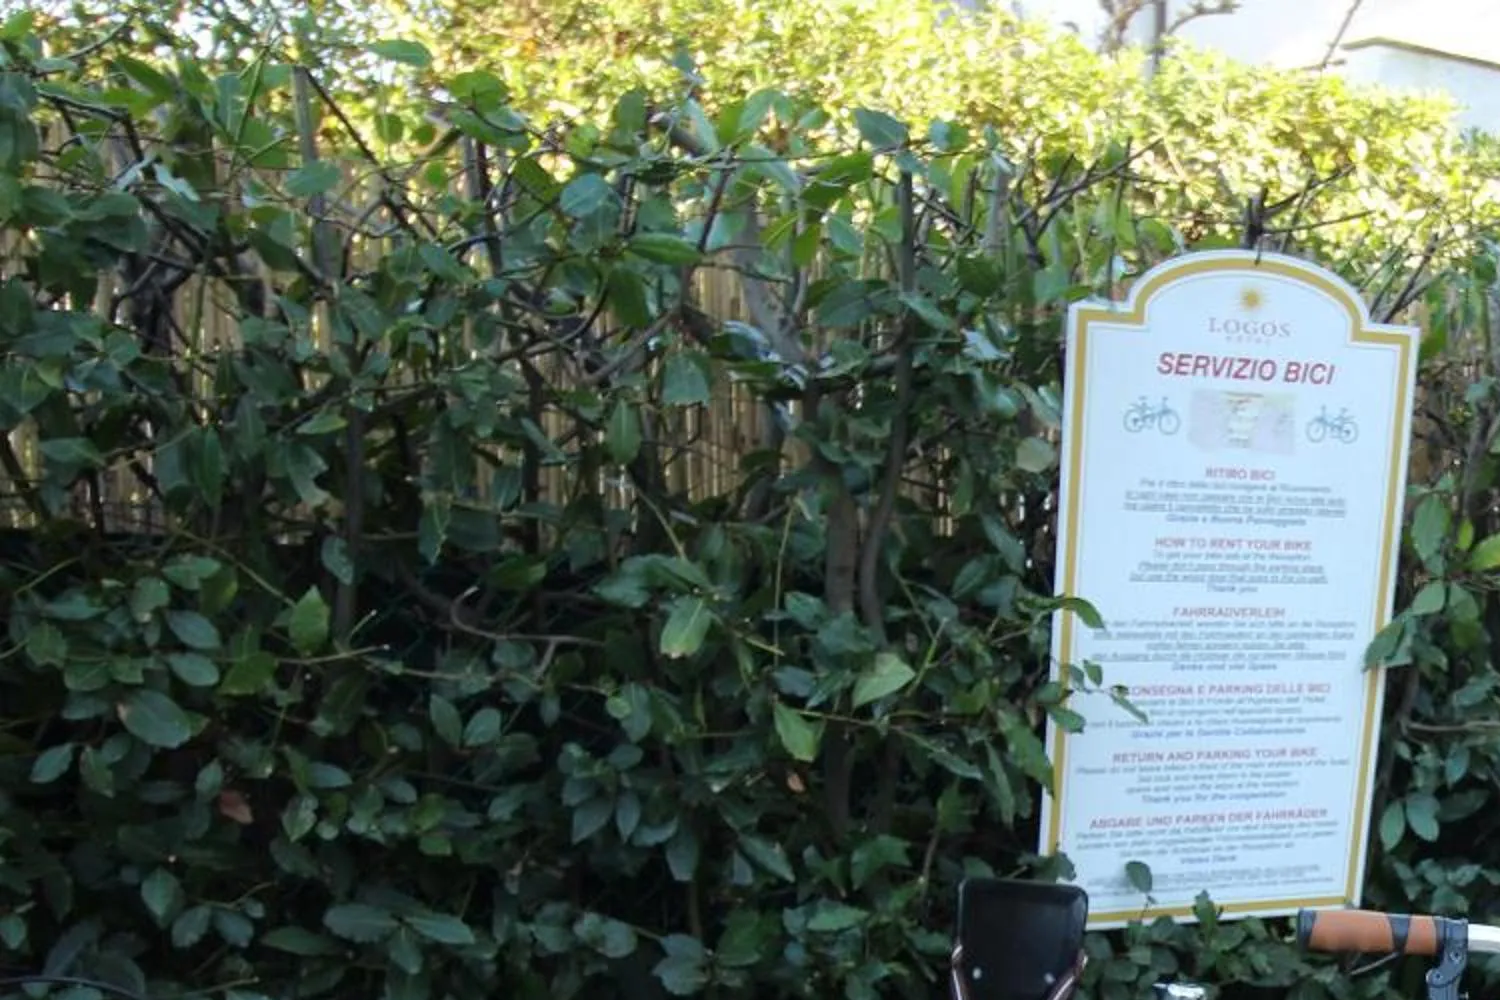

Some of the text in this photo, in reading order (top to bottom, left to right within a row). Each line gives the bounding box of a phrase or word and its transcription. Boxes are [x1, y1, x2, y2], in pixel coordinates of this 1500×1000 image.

[1208, 317, 1292, 338] LOGOS
[1157, 352, 1336, 385] SERVIZIO BICI
[1155, 538, 1312, 552] HOW TO RENT YOUR BIKE
[1209, 683, 1263, 696] PARKING
[1113, 752, 1164, 763] RETURN
[1167, 751, 1194, 761] AND
[1197, 749, 1251, 760] PARKING
[1255, 748, 1287, 758] YOUR
